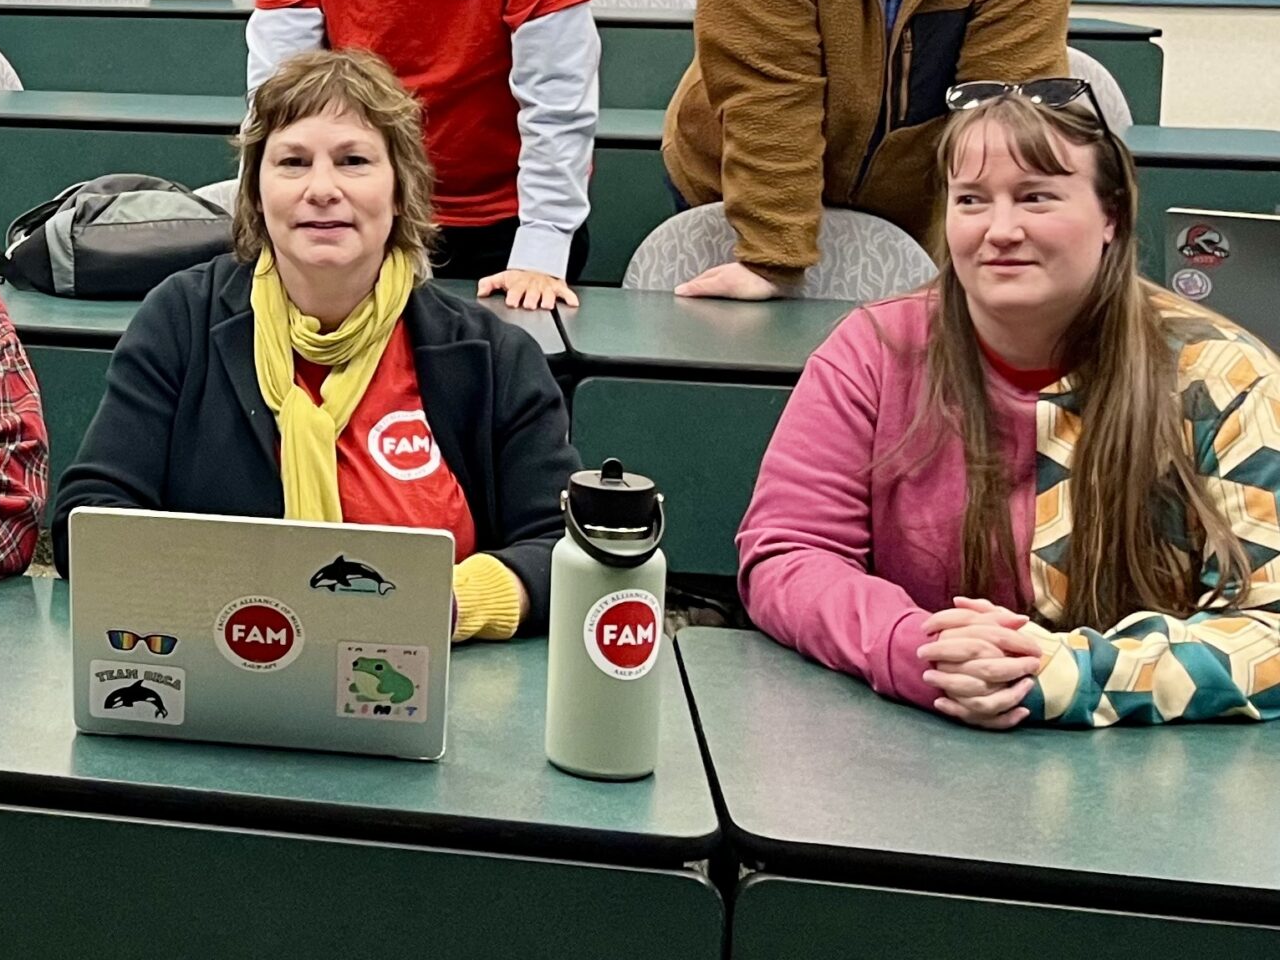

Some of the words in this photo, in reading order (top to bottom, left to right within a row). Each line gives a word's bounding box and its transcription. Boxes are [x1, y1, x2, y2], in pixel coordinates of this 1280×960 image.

[382, 435, 430, 455] FAM
[232, 624, 287, 646] FAM
[603, 622, 654, 646] FAM
[95, 668, 138, 682] TEAM
